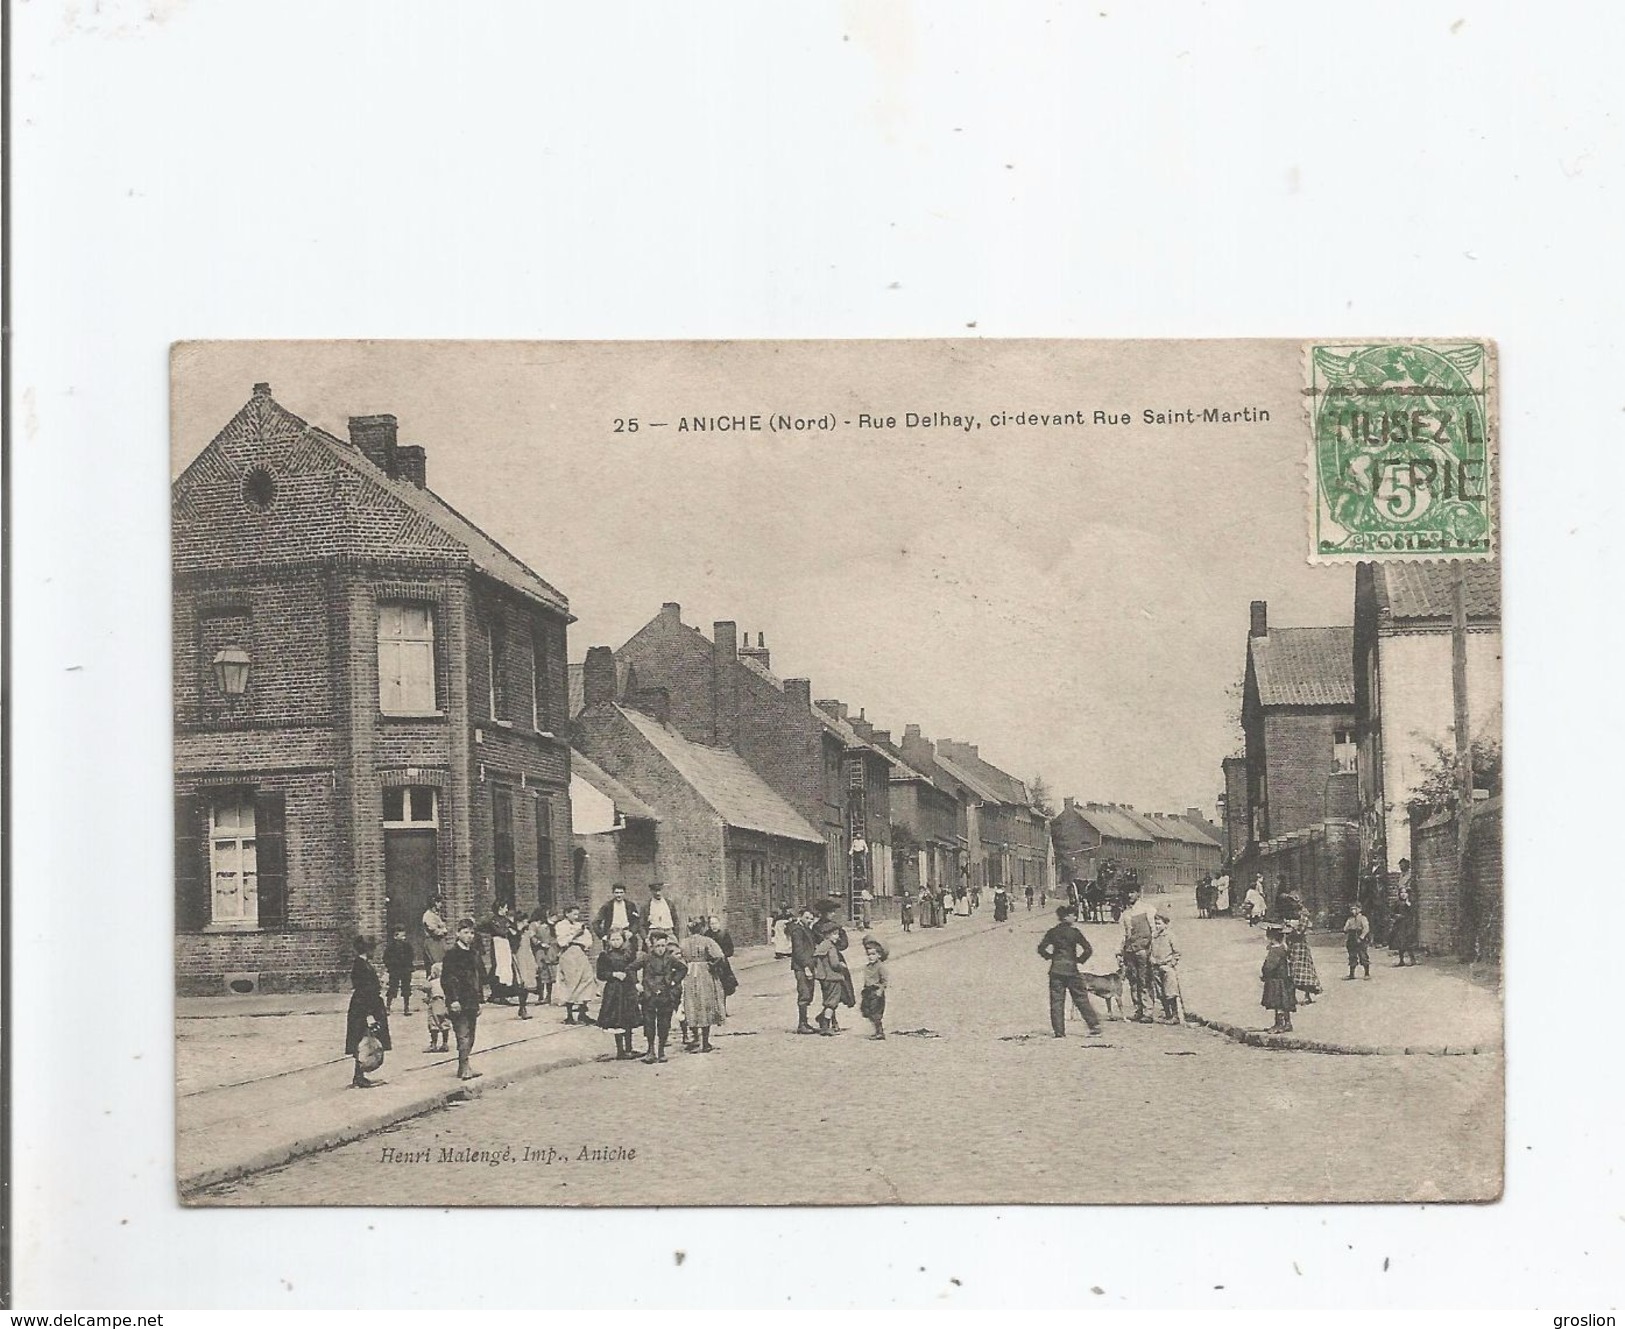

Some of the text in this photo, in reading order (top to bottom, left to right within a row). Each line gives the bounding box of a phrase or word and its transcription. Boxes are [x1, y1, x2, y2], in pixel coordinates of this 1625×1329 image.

[613, 418, 639, 433] 25
[678, 415, 762, 432] ANICHE
[769, 412, 837, 433] (Nord)
[858, 413, 897, 430] Rue
[905, 411, 982, 432] Delhay,
[989, 410, 1085, 427] ci-devant
[1093, 410, 1132, 426] Rue
[1143, 406, 1270, 425] Saint-Martin
[1386, 463, 1417, 519] 5
[379, 1147, 431, 1163] Henri
[575, 1145, 637, 1161] Aniche
